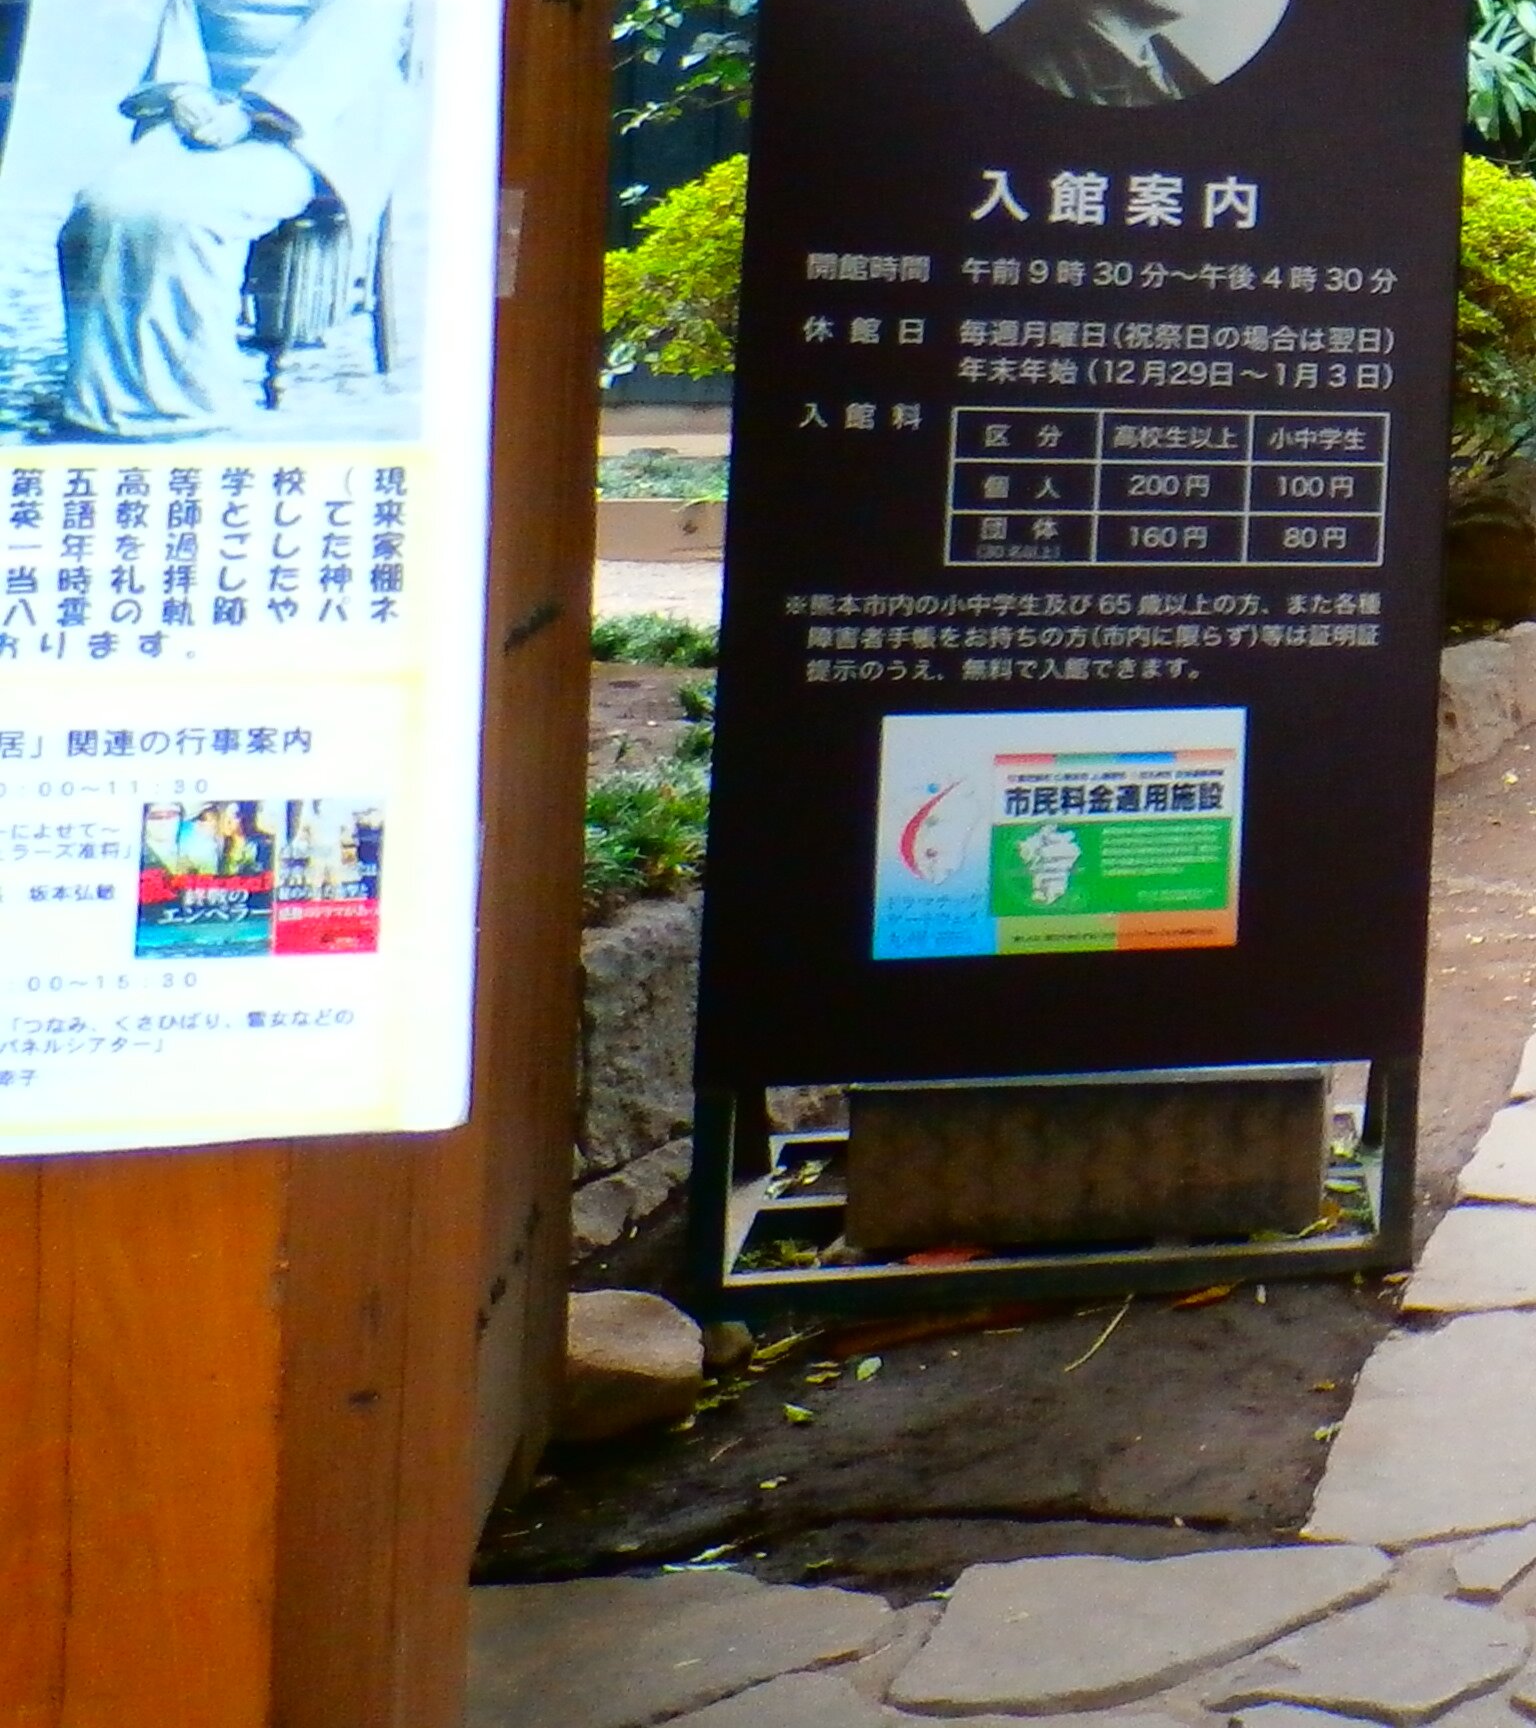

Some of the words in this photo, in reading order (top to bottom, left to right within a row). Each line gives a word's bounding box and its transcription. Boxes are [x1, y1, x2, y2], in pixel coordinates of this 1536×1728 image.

[970, 169, 1260, 229] 入館案内
[806, 252, 931, 283] 開館時間
[961, 256, 1399, 295] 午前9時30分～午後4時30分
[803, 316, 927, 345] 休館日
[799, 402, 923, 431] 入館料
[983, 424, 1064, 448] 区分
[1113, 425, 1238, 451] 高校生以上
[1269, 427, 1368, 452] 小中学生
[982, 475, 1062, 501] 個人
[1127, 474, 1211, 499] 200円
[1276, 476, 1356, 499] 100円
[9, 500, 405, 530] 英語教師として来
[1129, 526, 1209, 550] 160円
[1282, 525, 1348, 550] 80円
[5, 565, 403, 595] 当時礼拝した神棚
[3, 597, 400, 627] 八雲の軌跡やパネ
[1004, 783, 1225, 817] 市民料金適用施設
